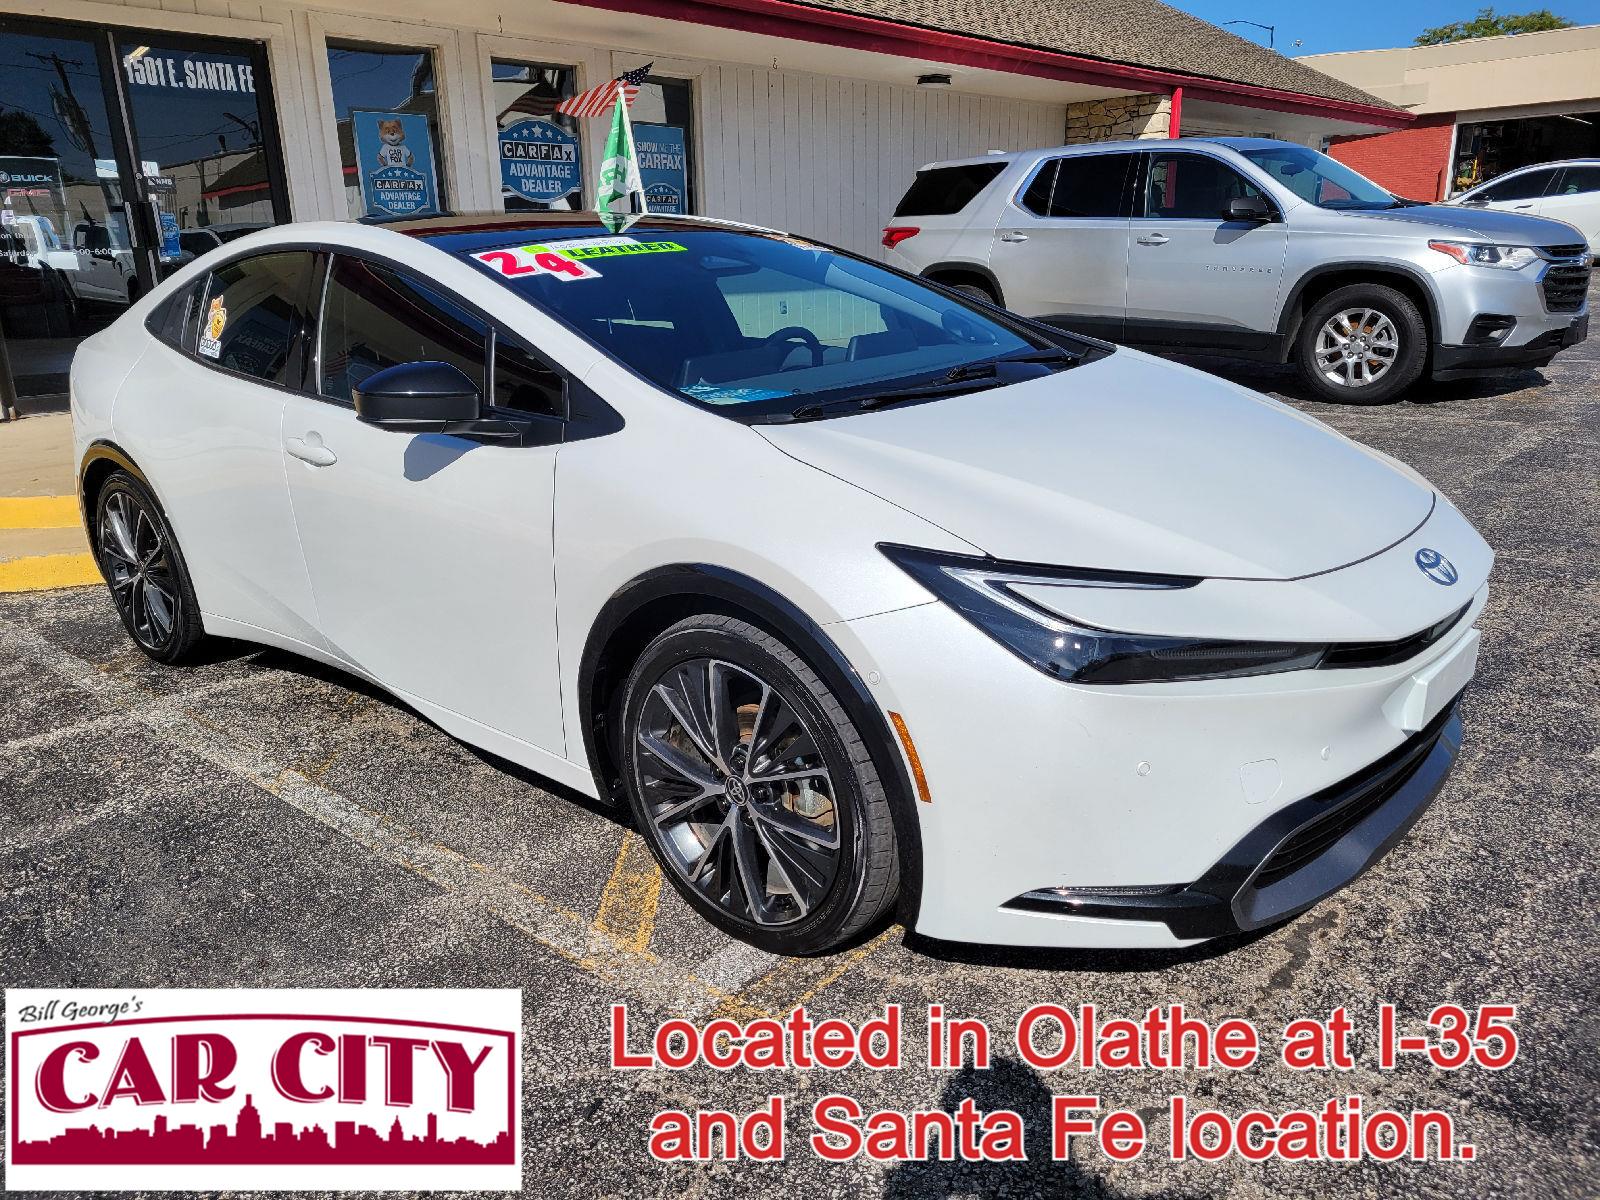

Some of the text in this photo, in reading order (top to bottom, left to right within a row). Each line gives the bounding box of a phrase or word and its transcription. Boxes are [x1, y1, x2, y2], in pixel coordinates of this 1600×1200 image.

[123, 54, 256, 93] 1501 E. SANTA FE
[502, 142, 574, 162] CARFAX
[636, 141, 658, 153] SHOW
[637, 153, 683, 171] CARFAX
[10, 174, 53, 182] BUICK
[509, 162, 572, 179] ADVANTAGE
[375, 180, 424, 190] CARFAX
[521, 178, 562, 193] DEALER
[380, 191, 422, 201] ADVANTAGE
[646, 195, 679, 204] CARFAX
[388, 201, 416, 210] DEALER
[566, 242, 676, 257] LEATHER
[479, 251, 586, 277] 24
